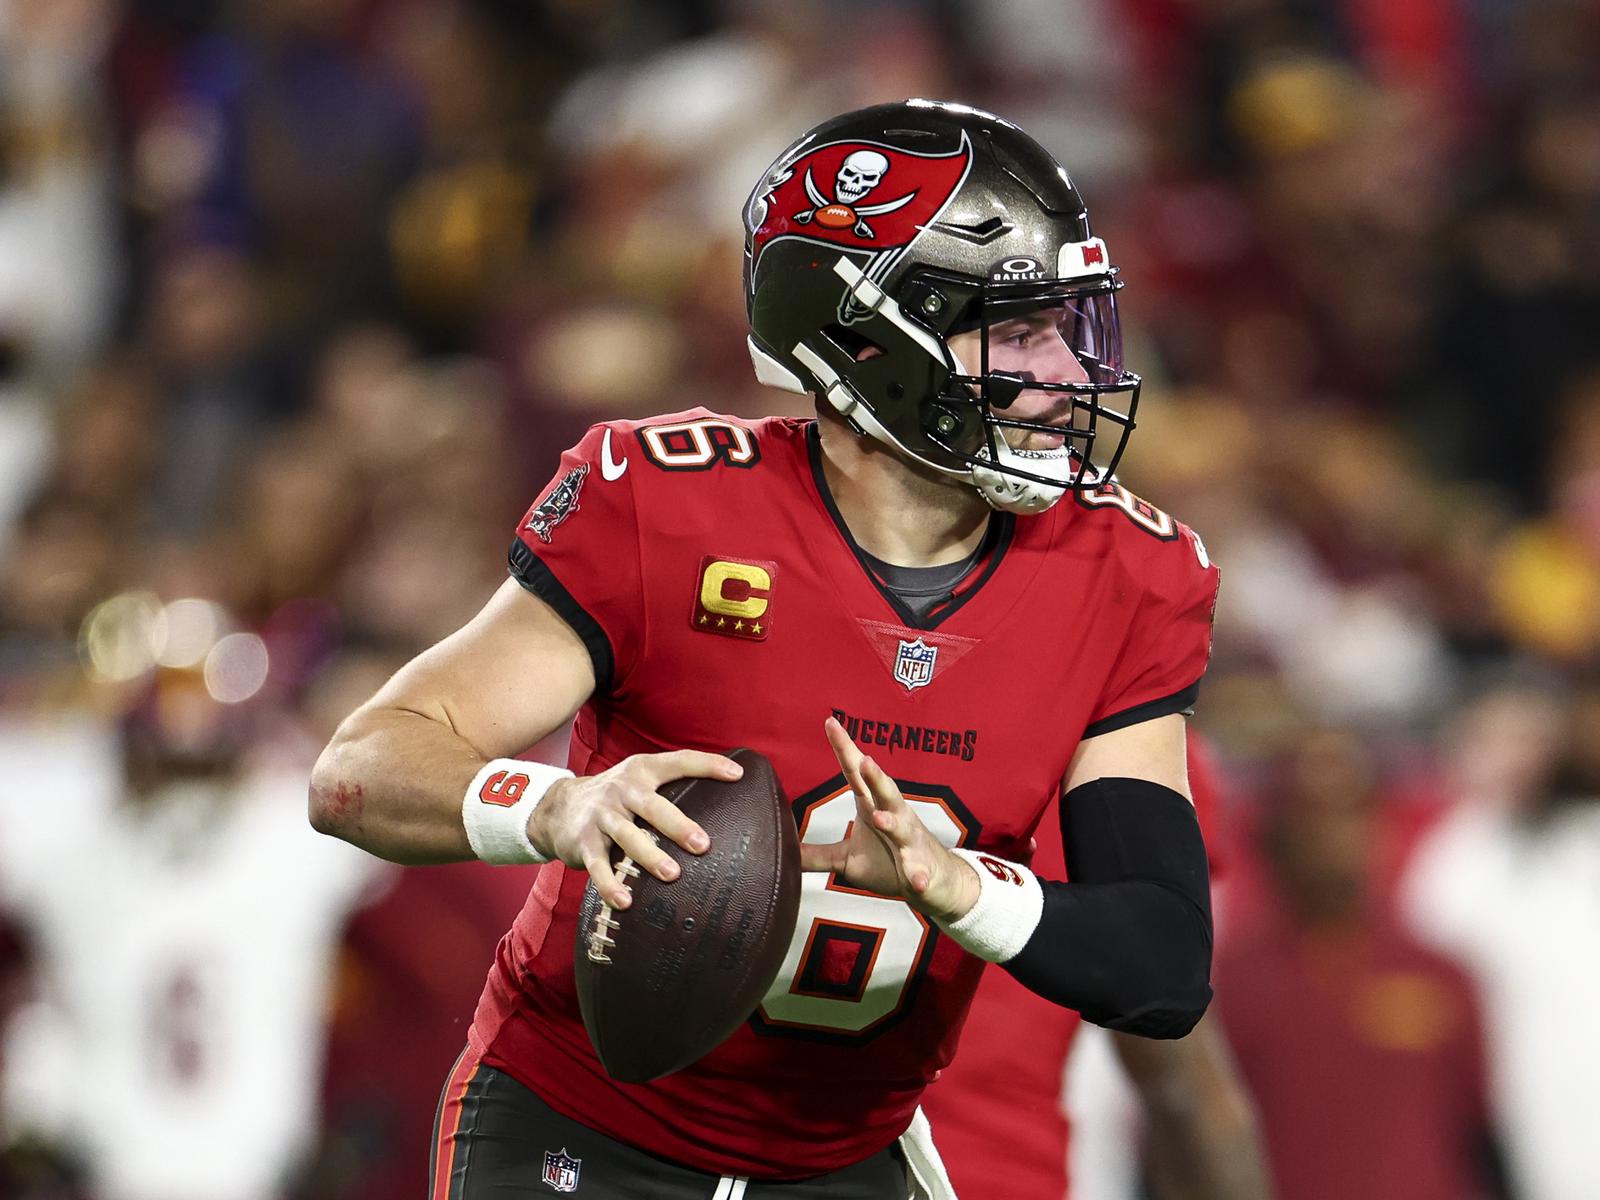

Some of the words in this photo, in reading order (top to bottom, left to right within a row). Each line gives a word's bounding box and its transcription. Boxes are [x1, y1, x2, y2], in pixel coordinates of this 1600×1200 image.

[993, 271, 1045, 281] OAKLEY
[636, 418, 762, 472] 6
[701, 561, 771, 619] C
[900, 660, 928, 680] NFL
[479, 770, 530, 808] 6
[754, 776, 983, 1046] 6
[547, 1165, 574, 1187] NFL
